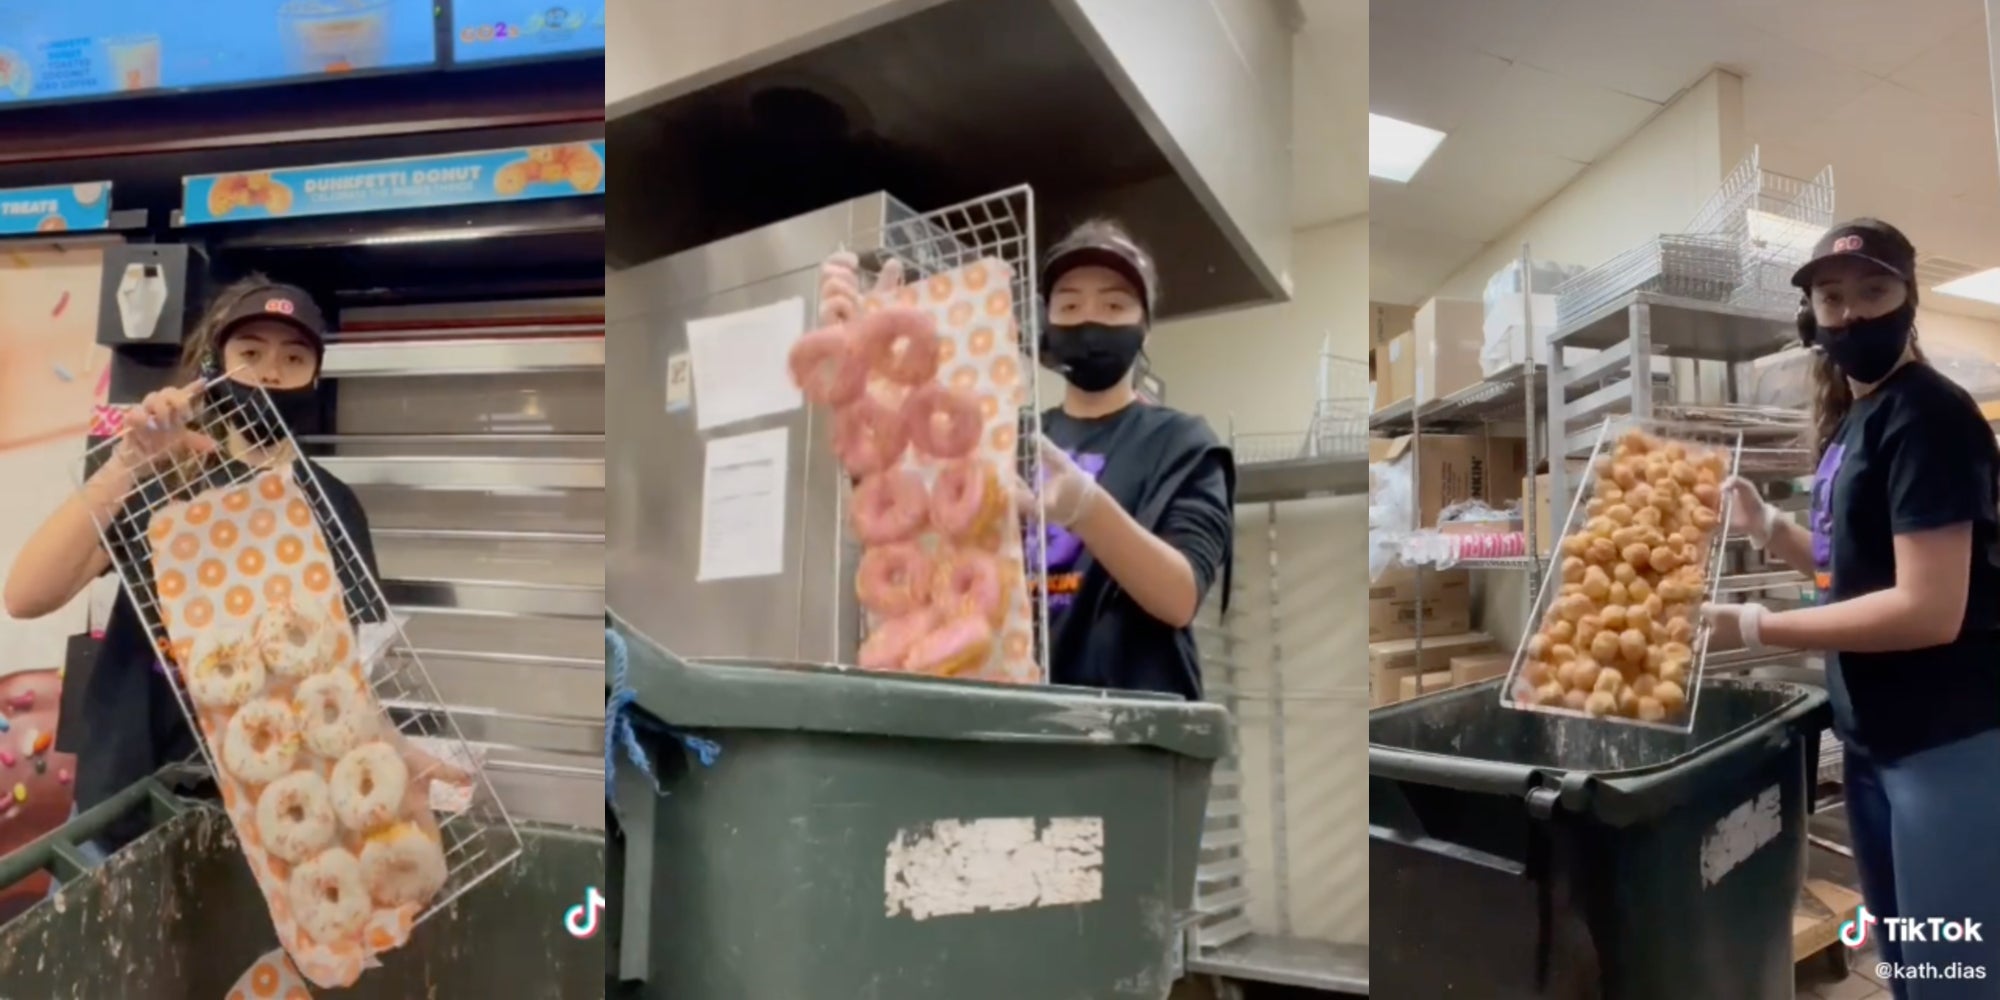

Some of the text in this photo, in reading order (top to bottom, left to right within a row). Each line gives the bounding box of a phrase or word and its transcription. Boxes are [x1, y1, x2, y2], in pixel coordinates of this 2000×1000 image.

[305, 171, 407, 193] DUNKFETTI
[413, 166, 482, 184] DONUT
[2, 199, 58, 215] TREATS
